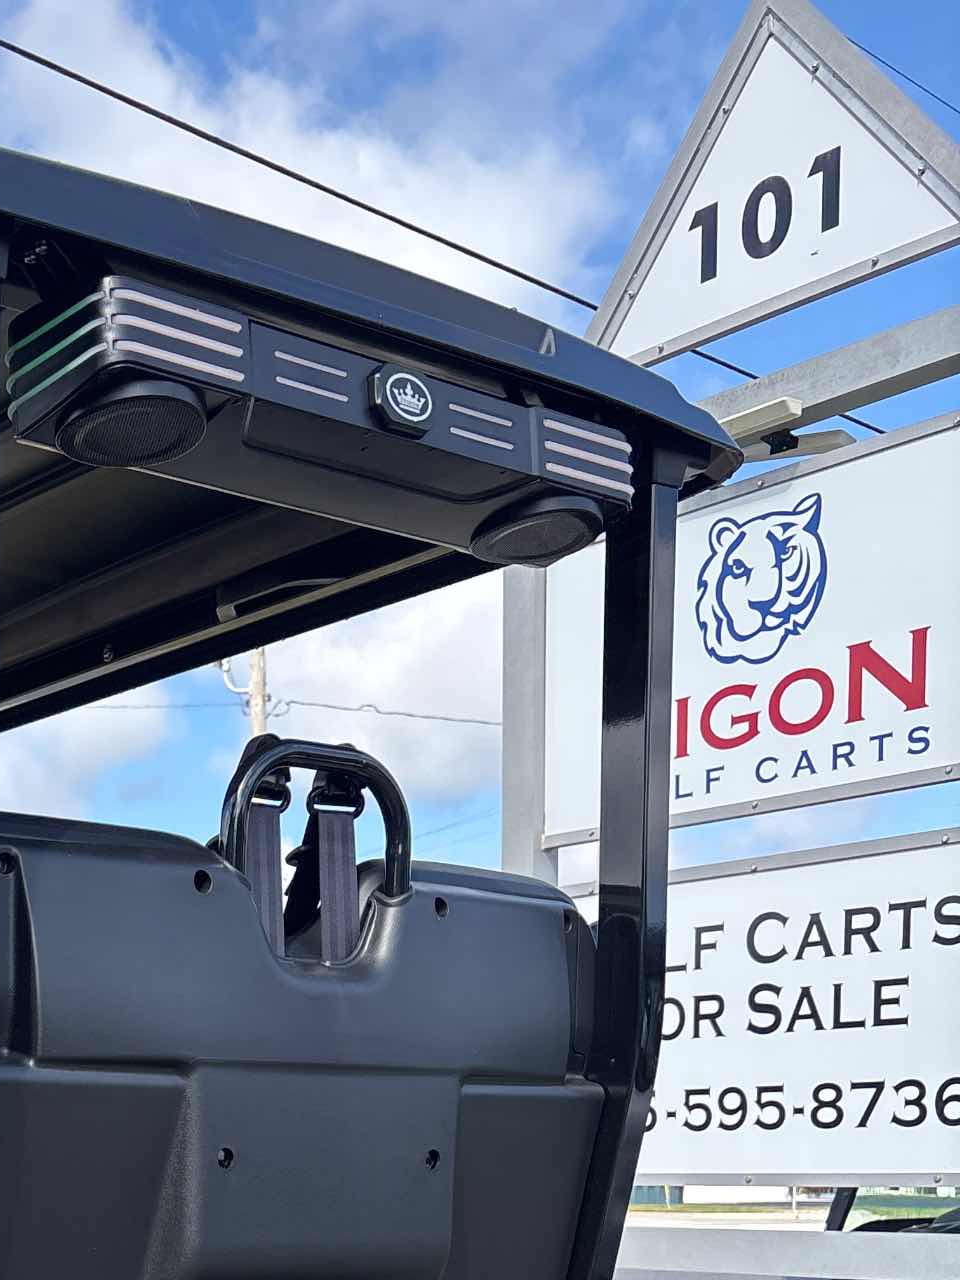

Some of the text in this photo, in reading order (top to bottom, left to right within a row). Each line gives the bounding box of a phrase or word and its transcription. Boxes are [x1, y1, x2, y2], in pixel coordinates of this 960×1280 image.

[688, 145, 842, 284] 101
[674, 626, 931, 759] IGON
[674, 726, 930, 799] LF CARTS
[746, 895, 960, 964] CARTS
[662, 975, 910, 1040] OR SALE
